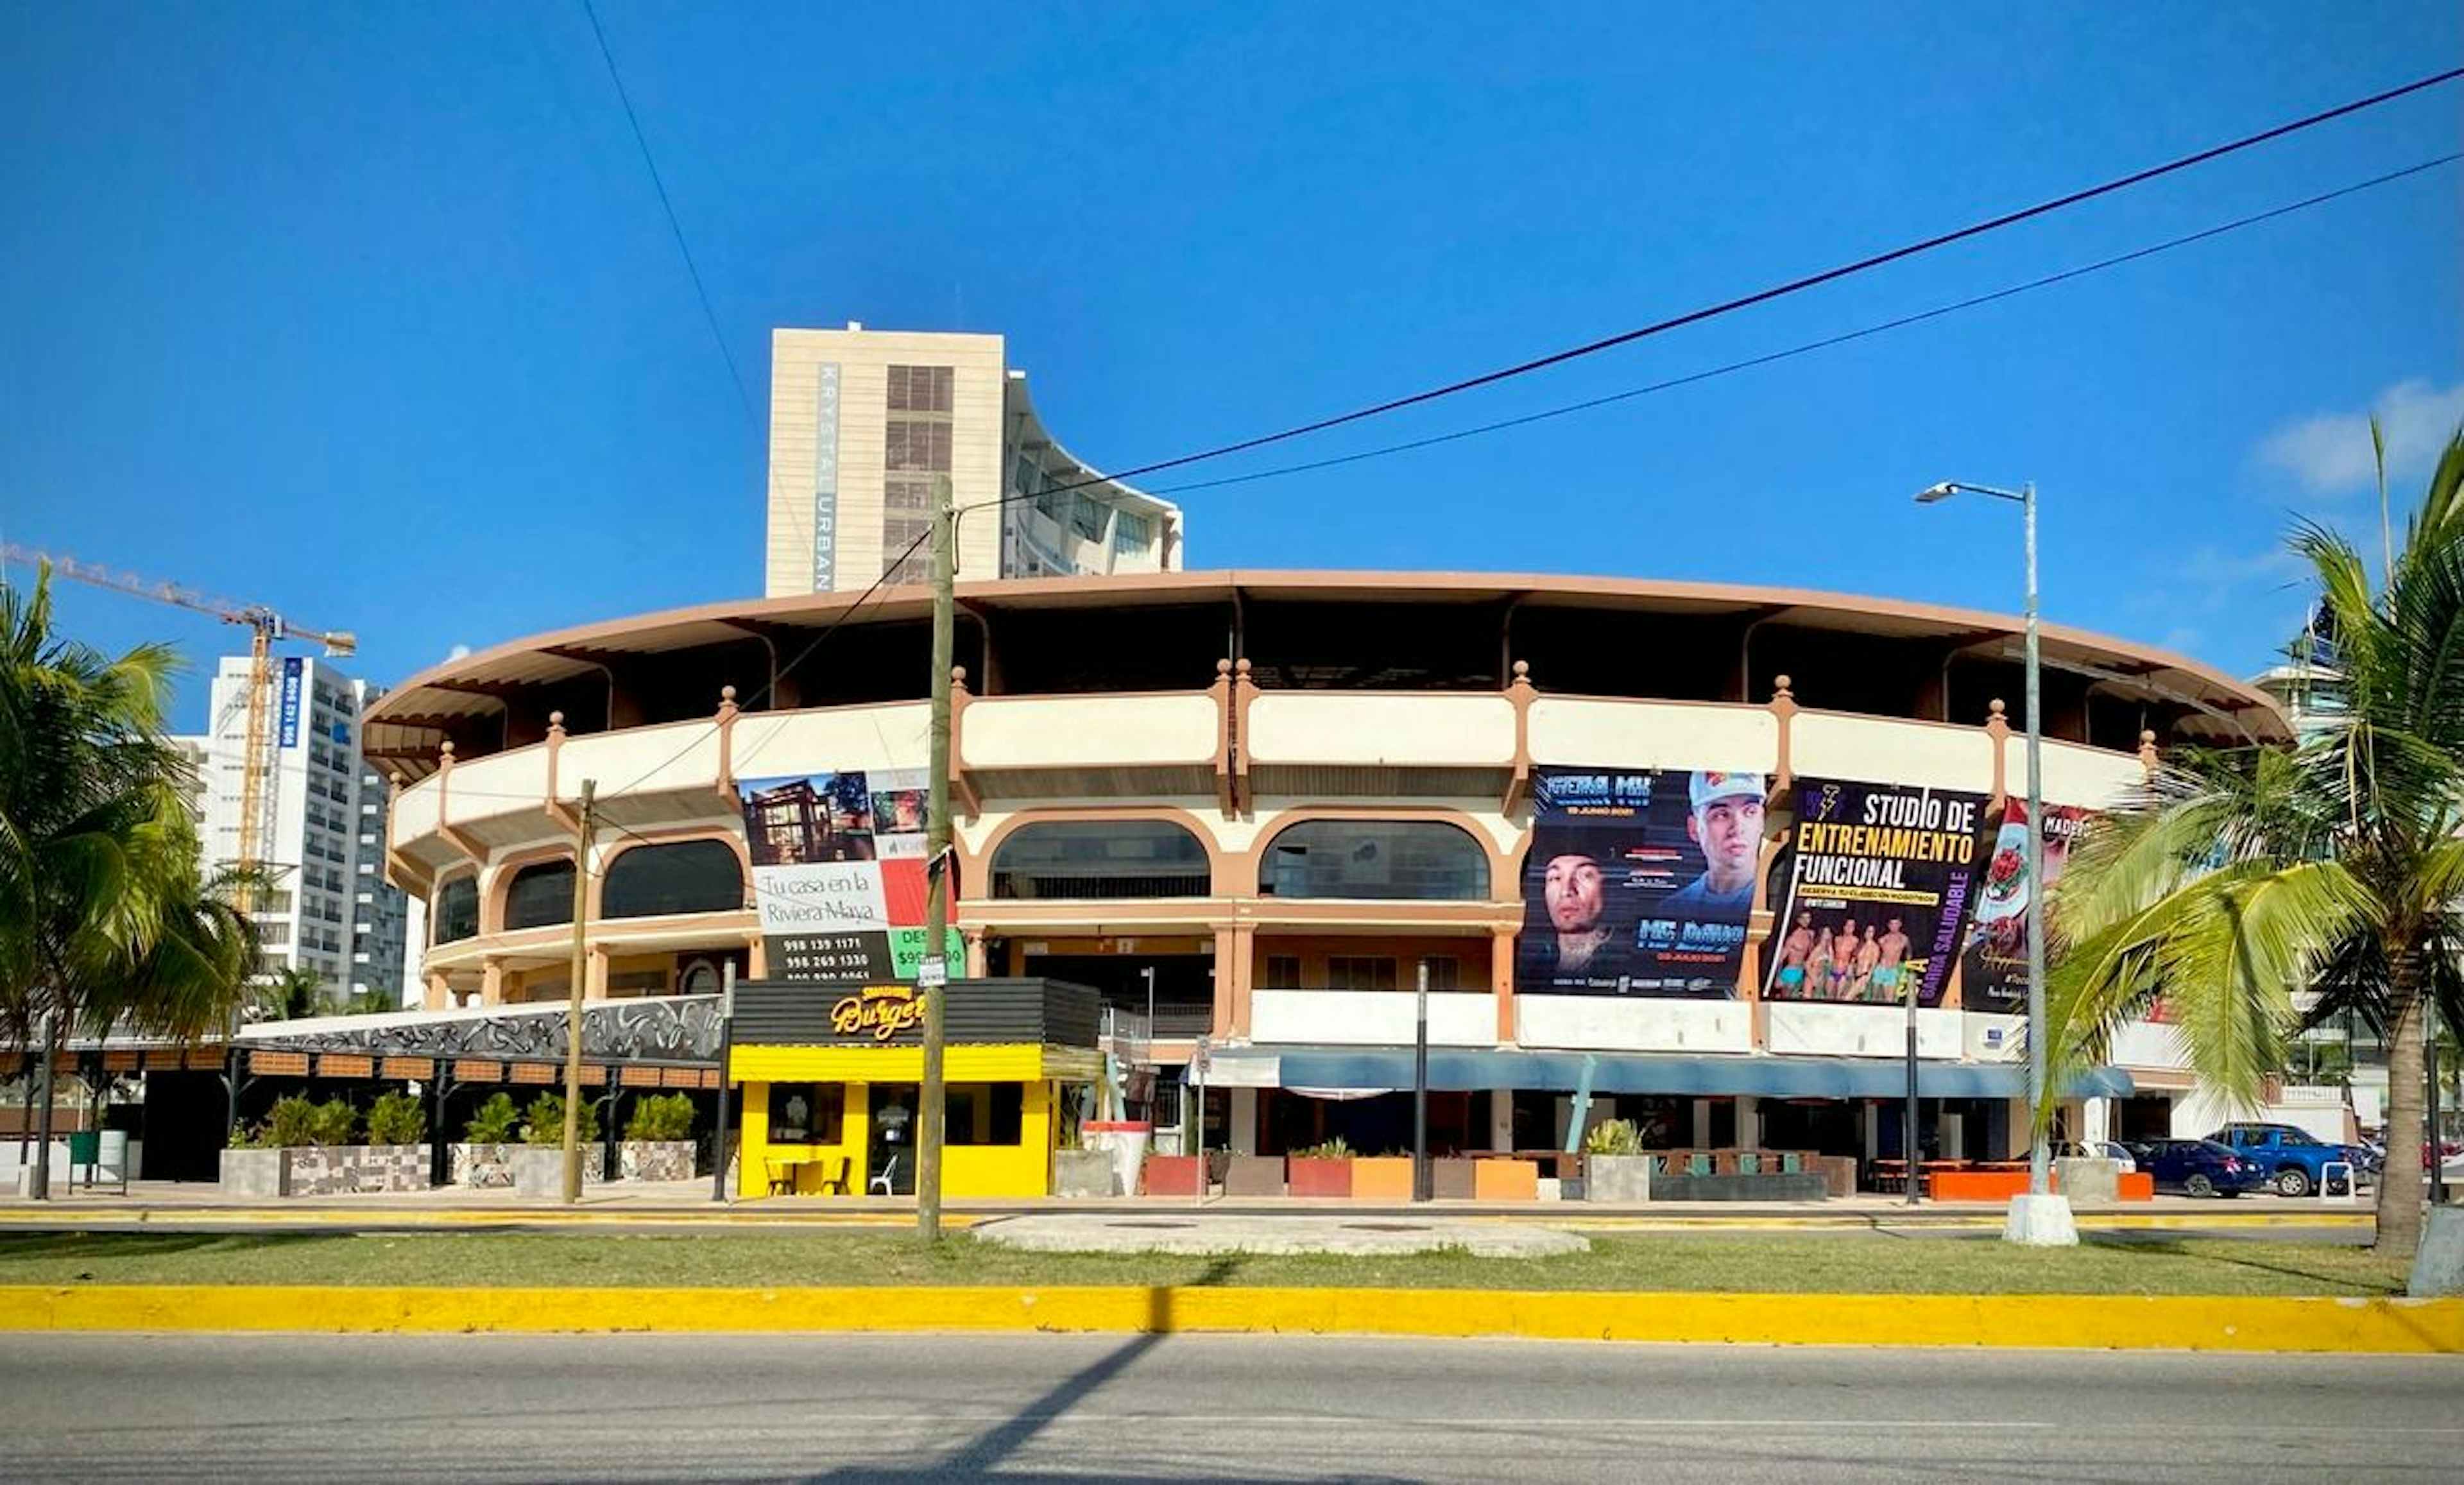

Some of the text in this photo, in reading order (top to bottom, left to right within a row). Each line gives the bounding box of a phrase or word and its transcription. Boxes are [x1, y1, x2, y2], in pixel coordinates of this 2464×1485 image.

[816, 366, 836, 589] KRYSTAL URBAN
[1863, 794, 1942, 829] STUDIO
[1946, 801, 1976, 833] DE
[1797, 822, 1974, 864] ENTRENAMIENTO
[760, 872, 869, 895] Tu casa en la
[1795, 854, 1905, 889] FUNCIONAL
[767, 900, 873, 924] Riviera Maya
[1934, 871, 1969, 952] SALUDABLE
[783, 939, 807, 952] 998
